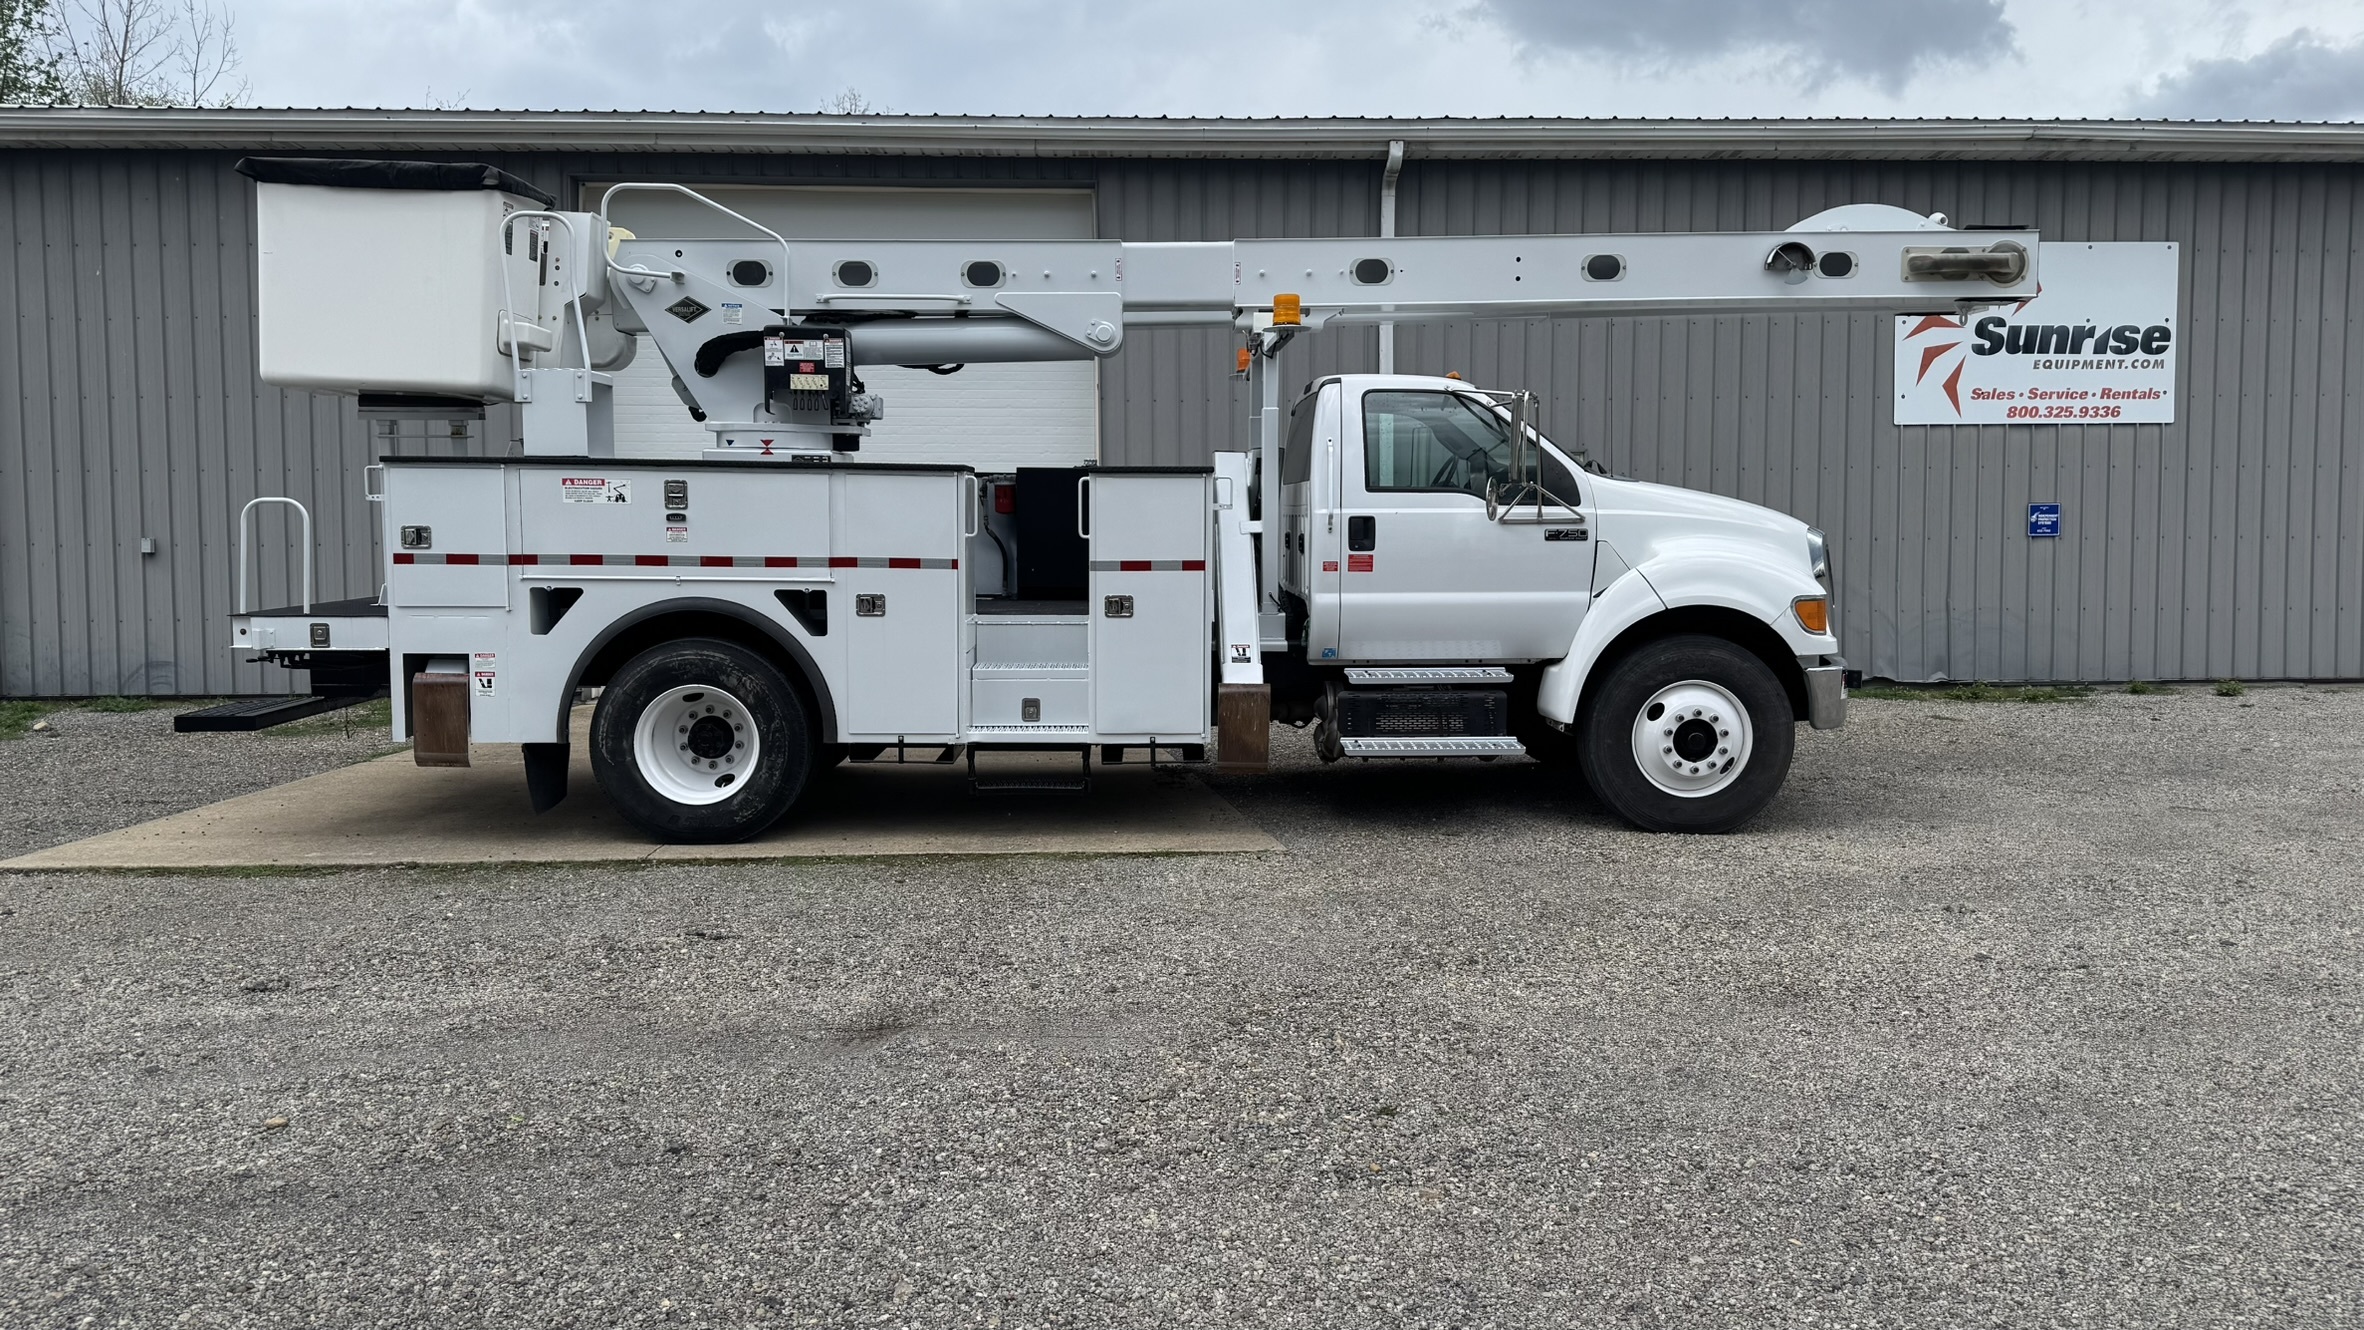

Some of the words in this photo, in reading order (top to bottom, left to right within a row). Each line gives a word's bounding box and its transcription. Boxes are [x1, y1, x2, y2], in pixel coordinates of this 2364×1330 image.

[1971, 316, 2172, 356] Sunrise
[2032, 359, 2165, 370] EQUIPMENT.COM
[1970, 387, 2016, 400] Sales
[2027, 387, 2089, 400] Service
[2100, 387, 2161, 400] Rentals
[2006, 405, 2121, 419] 800.325.9336
